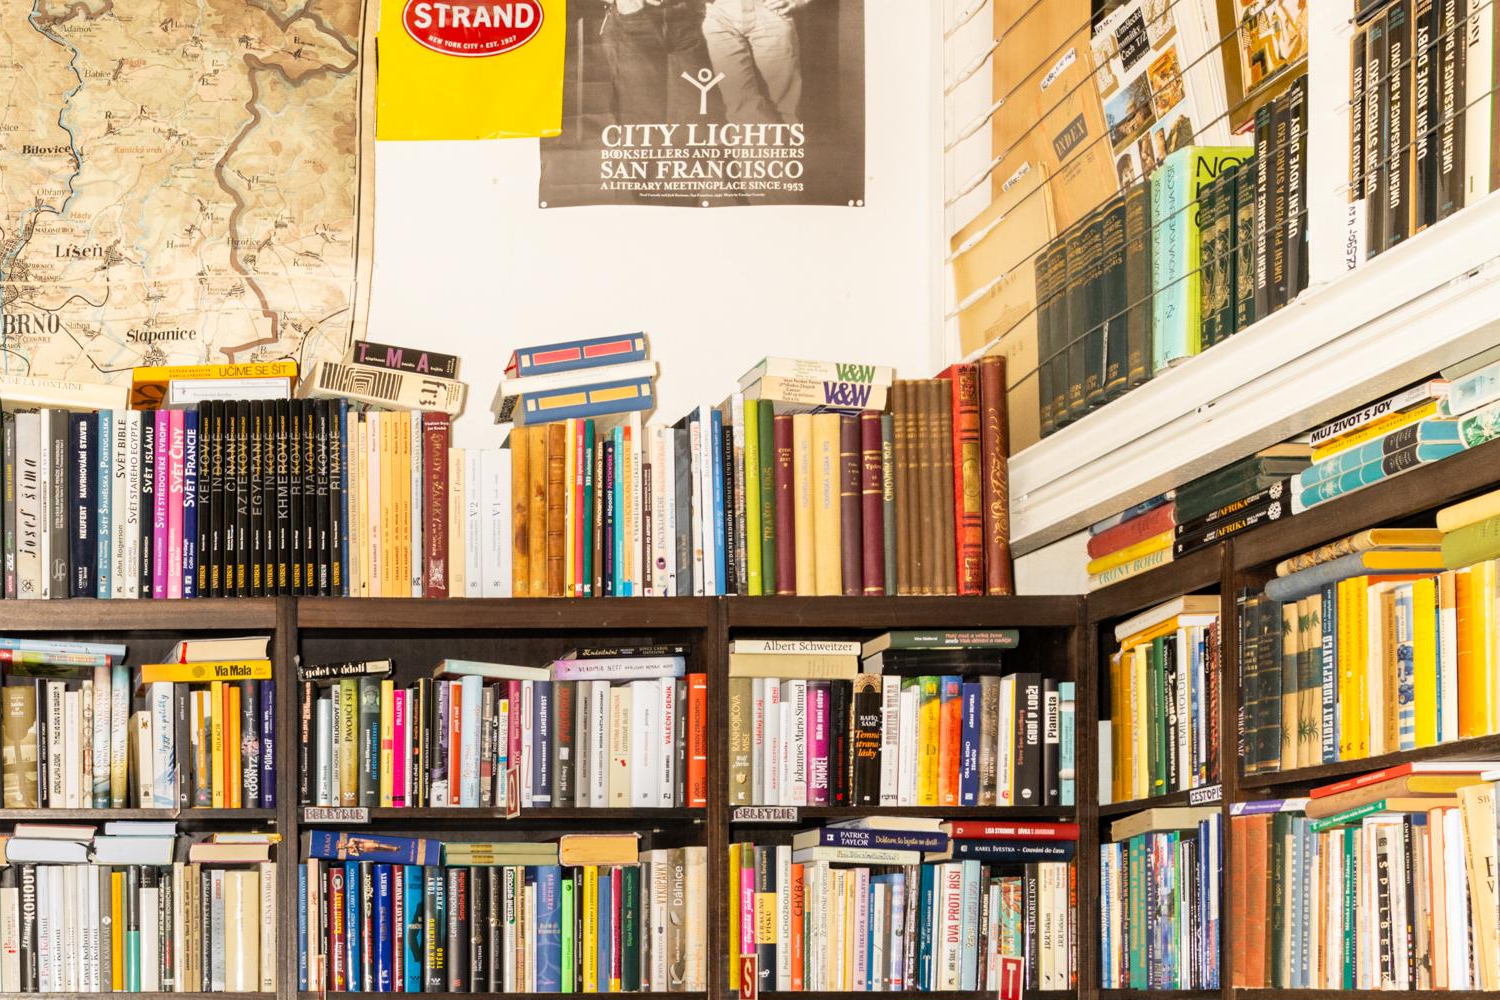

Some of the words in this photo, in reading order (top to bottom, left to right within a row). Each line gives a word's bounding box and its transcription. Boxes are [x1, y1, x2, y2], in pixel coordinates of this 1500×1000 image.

[414, 1, 534, 30] STRAND
[427, 35, 443, 45] NEW
[444, 39, 461, 48] YORK
[500, 35, 517, 46] 1927
[602, 125, 677, 147] CITY
[688, 123, 804, 146] LIGHTS
[601, 149, 689, 159] BOOKSELLERS
[692, 149, 721, 158] AND
[724, 148, 804, 158] PUBLISHERS
[601, 160, 651, 179] SAN
[656, 159, 803, 179] FRANCISCO
[610, 181, 661, 190] LITERARY
[664, 181, 746, 190] MEETINGPLACE
[749, 181, 781, 189] SINCE
[783, 181, 804, 191] 1953
[3, 313, 60, 336] BRNO
[218, 365, 251, 378] UČÍME
[253, 366, 265, 377] SE
[268, 364, 287, 376] ŠÍT
[836, 364, 876, 384] V&W
[824, 382, 871, 407] V&W
[143, 426, 153, 465] ISLÁMU
[186, 430, 196, 474] FRANCIE
[143, 468, 153, 493] SVĚT
[184, 479, 196, 507] SVĚT
[1220, 499, 1248, 517] AFRIKA
[763, 642, 796, 651] Albert
[799, 642, 853, 652] Schweitzer
[215, 666, 229, 675] Via
[231, 665, 252, 676] Mala
[1179, 672, 1187, 714] HOLUB
[1048, 696, 1057, 739] Pianista
[1179, 718, 1187, 746] EMIL
[840, 831, 869, 839] PATRICK
[675, 864, 683, 906] Dálnice
[795, 878, 803, 917] CHYBA
[949, 892, 959, 923] PROTI
[948, 925, 959, 943] DVA
[744, 960, 752, 997] Š
[1007, 964, 1015, 999] T
